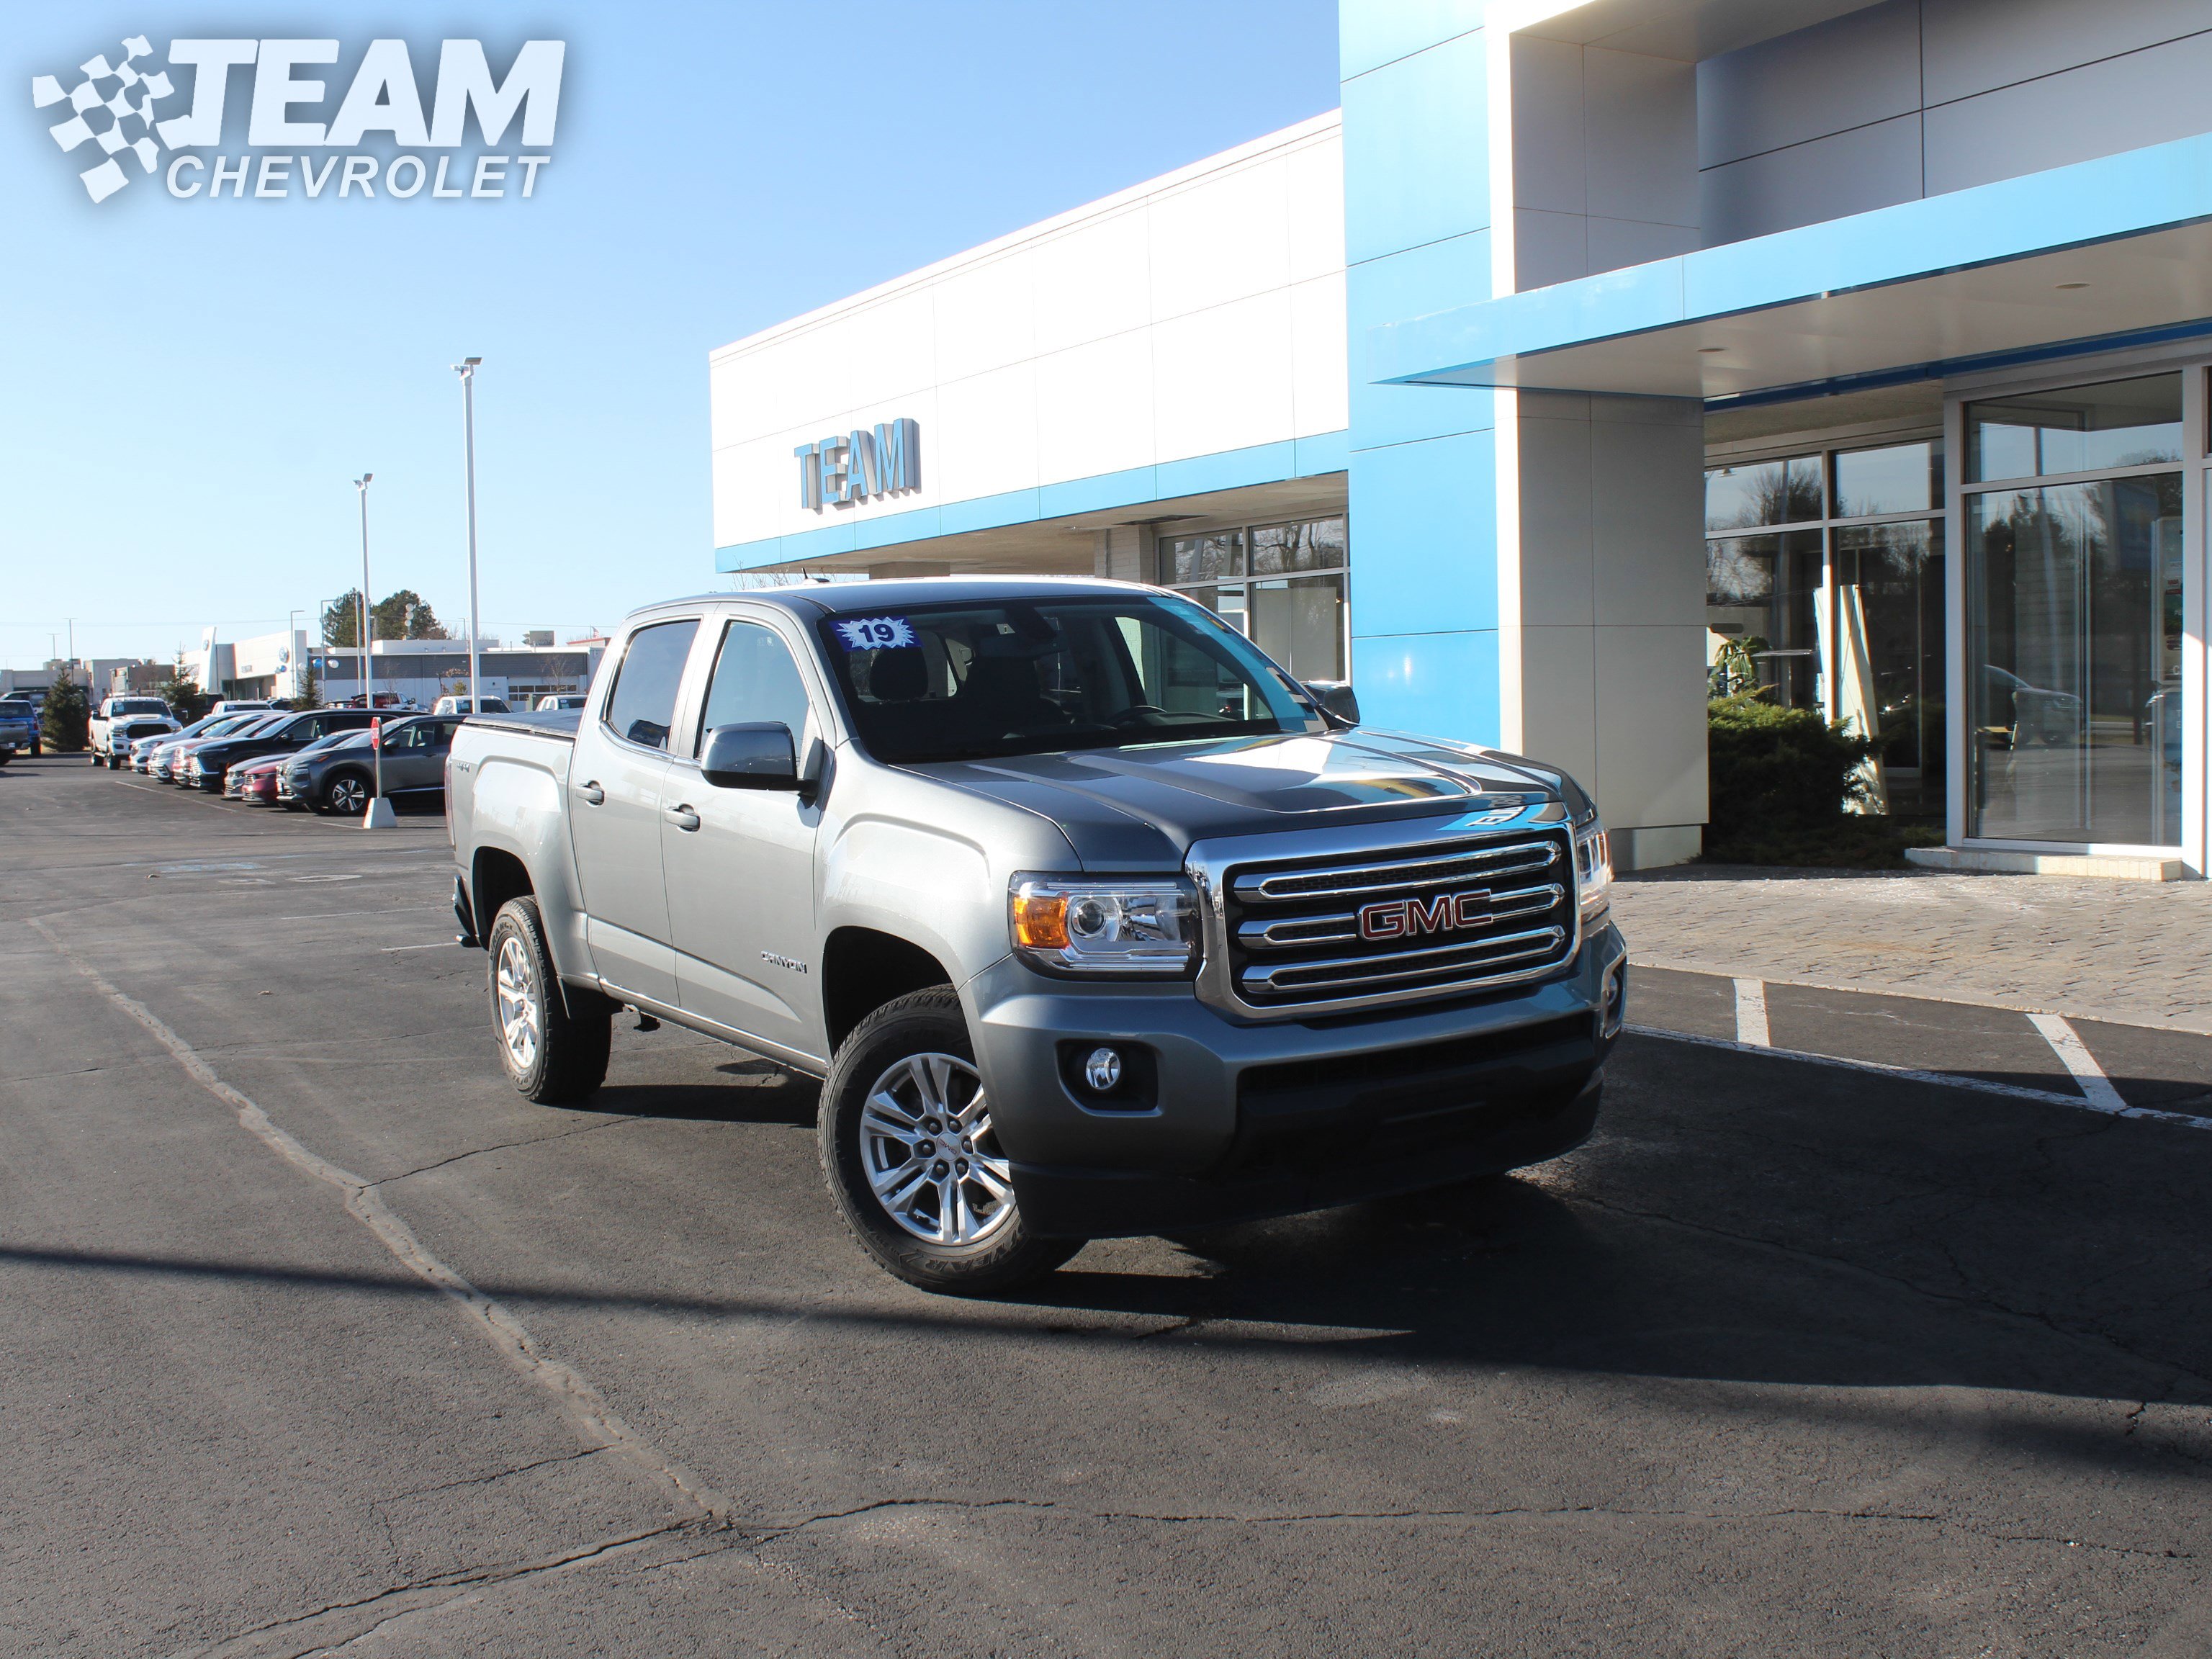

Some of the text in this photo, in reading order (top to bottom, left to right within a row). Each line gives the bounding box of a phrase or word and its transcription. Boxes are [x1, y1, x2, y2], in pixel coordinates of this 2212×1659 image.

[793, 418, 916, 510] TEAM
[858, 624, 895, 642] 19
[1359, 889, 1493, 940] GMC
[760, 950, 807, 974] CANYON
